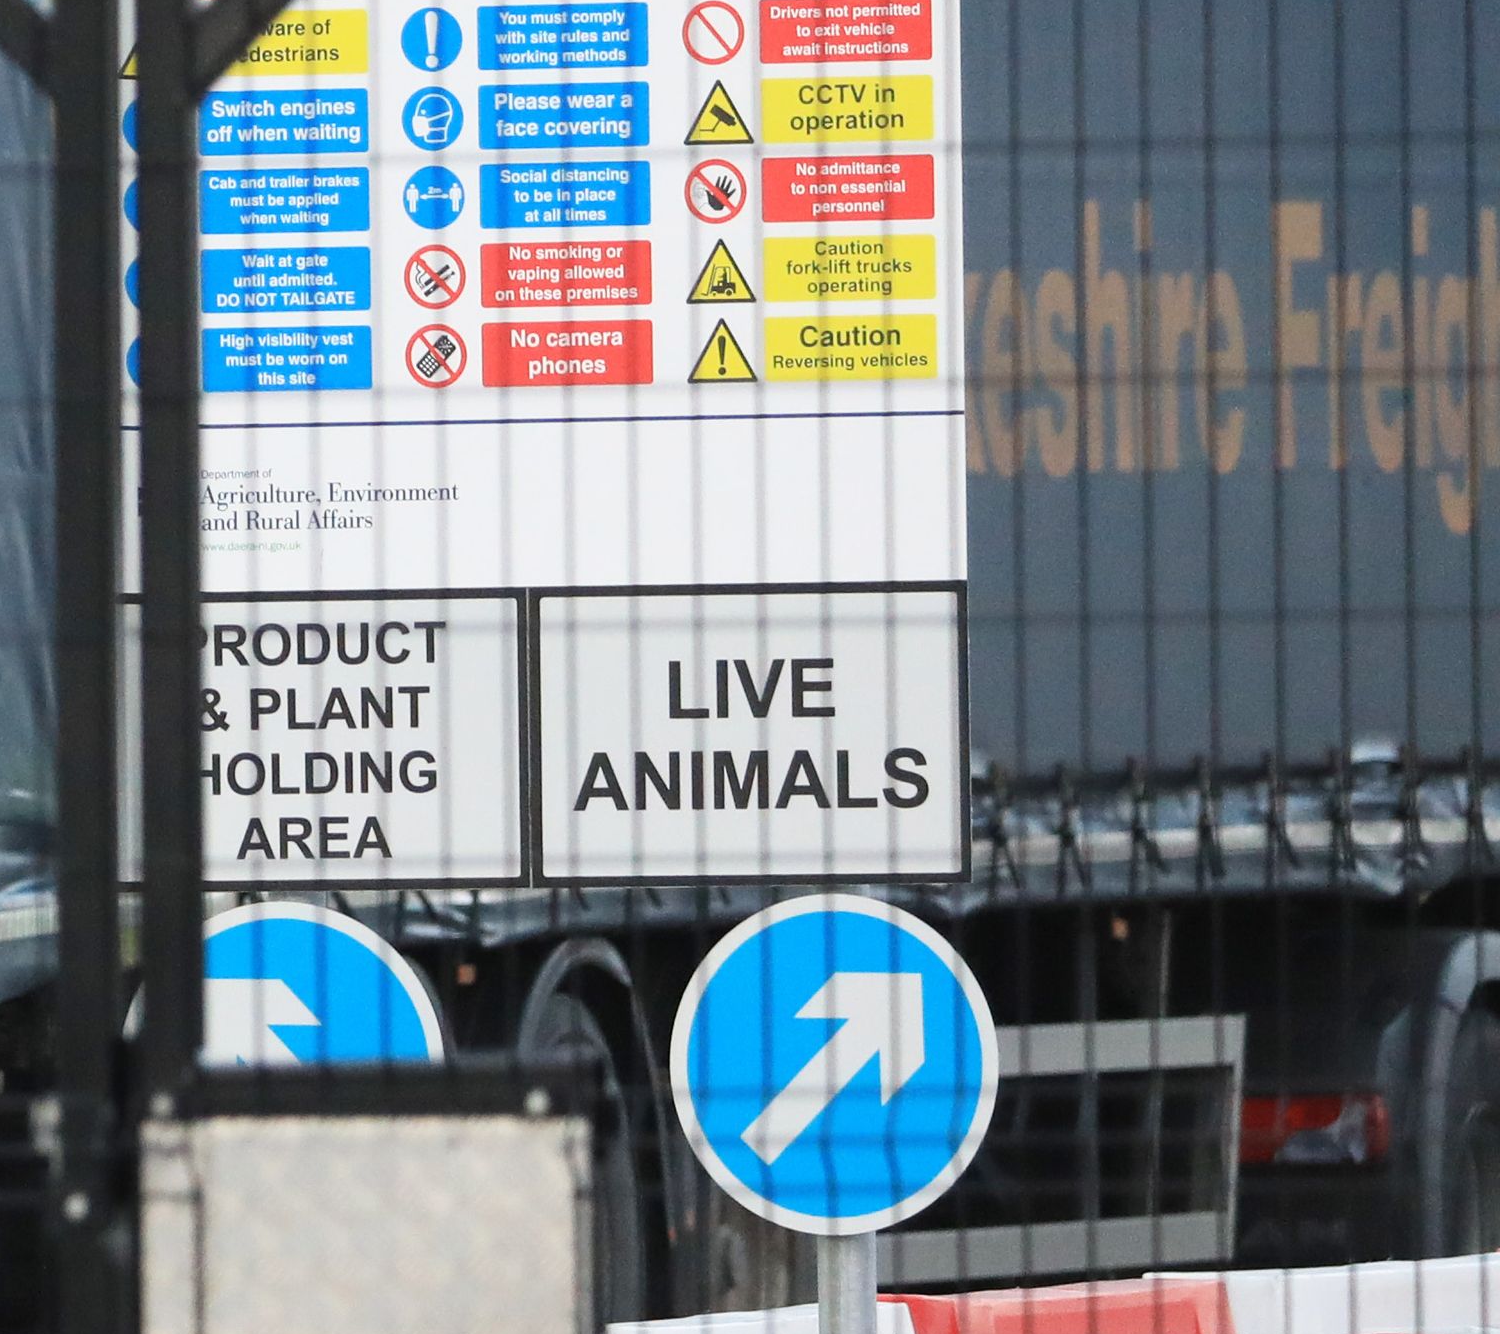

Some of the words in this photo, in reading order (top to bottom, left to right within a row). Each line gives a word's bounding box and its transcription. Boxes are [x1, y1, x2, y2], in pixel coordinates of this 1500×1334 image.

[770, 5, 821, 19] Drivers
[826, 4, 849, 18] not
[853, 3, 921, 19] permitted
[494, 93, 561, 111] Please
[567, 93, 614, 109] wear
[620, 94, 633, 108] a
[798, 84, 866, 105] CCTV
[875, 85, 895, 103] in
[212, 100, 275, 117] Switch
[281, 99, 355, 119] engines
[496, 119, 538, 137] face
[545, 117, 631, 139] covering
[790, 110, 904, 135] operation
[207, 126, 231, 142] off
[238, 125, 287, 142] when
[294, 124, 361, 144] waiting
[500, 169, 546, 184] Social
[551, 168, 629, 184] distancing
[796, 162, 817, 176] No
[820, 162, 901, 175] admittance
[514, 189, 529, 203] to
[534, 189, 552, 202] be
[557, 189, 570, 201] in
[575, 188, 615, 204] place
[791, 182, 805, 194] to
[810, 183, 836, 194] non
[841, 180, 905, 193] essential
[525, 209, 539, 222] at
[544, 208, 560, 222] all
[566, 207, 606, 221] times
[812, 199, 885, 216] personnel
[509, 246, 531, 260] No
[536, 244, 601, 262] smoking
[606, 246, 623, 259] or
[815, 240, 884, 256] Caution
[243, 255, 274, 267] Wait
[279, 255, 293, 267] at
[296, 254, 328, 270] gate
[787, 259, 850, 275] fork-lift
[857, 259, 912, 274] trucks
[234, 274, 265, 287] until
[269, 273, 338, 286] admitted.
[508, 266, 560, 283] vaping
[564, 264, 624, 279] allowed
[495, 289, 515, 302] on
[519, 287, 562, 300] these
[567, 285, 638, 302] premises
[808, 278, 892, 296] operating
[216, 293, 240, 308] DO
[244, 292, 277, 307] NOT
[281, 291, 355, 306] TAILGATE
[510, 329, 540, 348] No
[546, 329, 623, 347] camera
[800, 325, 901, 348] Caution
[529, 355, 606, 379] phones
[773, 355, 855, 370] Reversing
[861, 352, 928, 367] vehicles
[262, 469, 272, 478] of
[201, 483, 322, 511] Agriculture,
[328, 482, 460, 503] Environment
[201, 512, 237, 531] and
[246, 510, 300, 530] Rural
[307, 509, 373, 529] Affairs
[668, 658, 836, 719] LIVE
[201, 688, 231, 732] &
[249, 686, 431, 731] PLANT
[573, 747, 930, 812] ANIMALS
[236, 815, 393, 860] AREA
